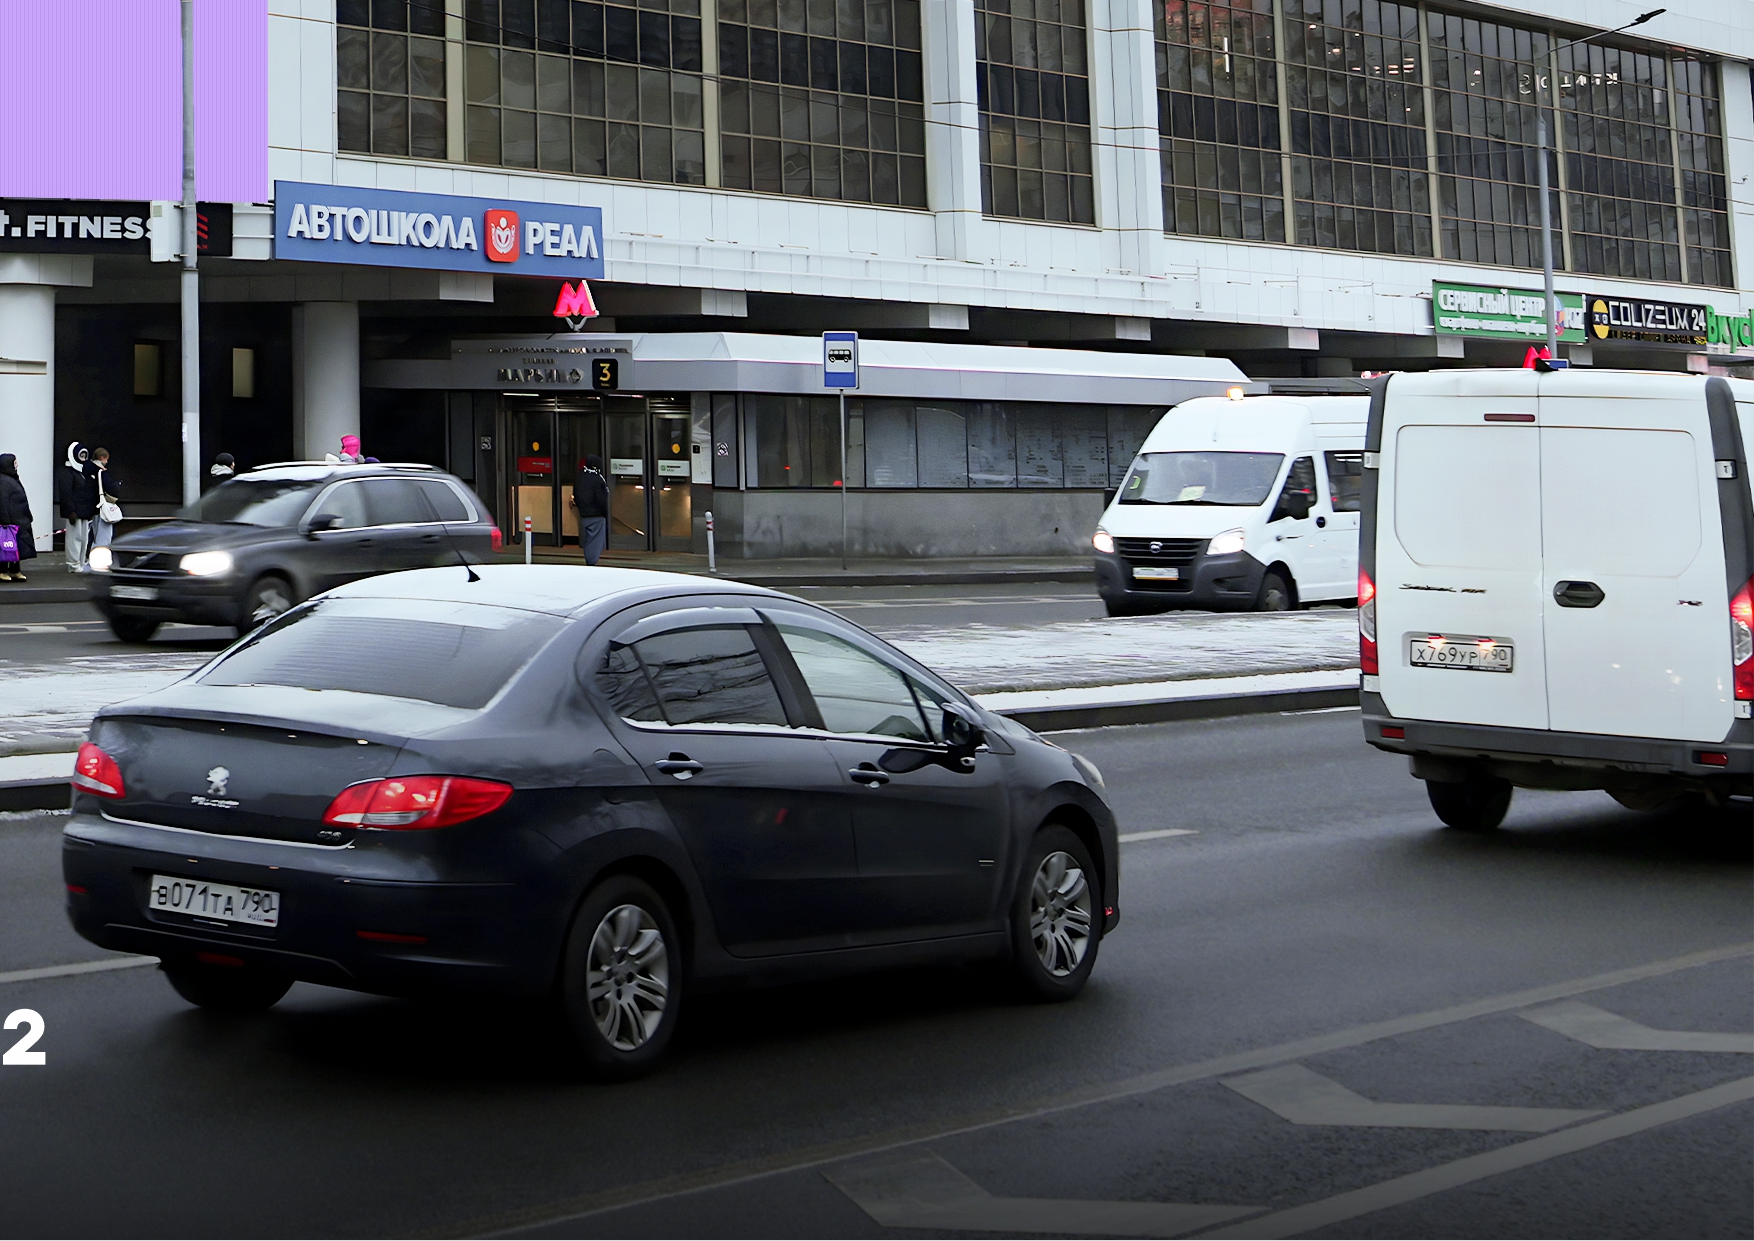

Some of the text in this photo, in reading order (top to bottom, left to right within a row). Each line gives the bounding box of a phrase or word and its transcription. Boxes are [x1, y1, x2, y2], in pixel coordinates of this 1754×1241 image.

[287, 203, 478, 251] АВТОШКОЛА
[524, 221, 599, 259] РЕАЛ
[1608, 300, 1706, 332] COLIZEUM 24
[599, 363, 611, 382] 3
